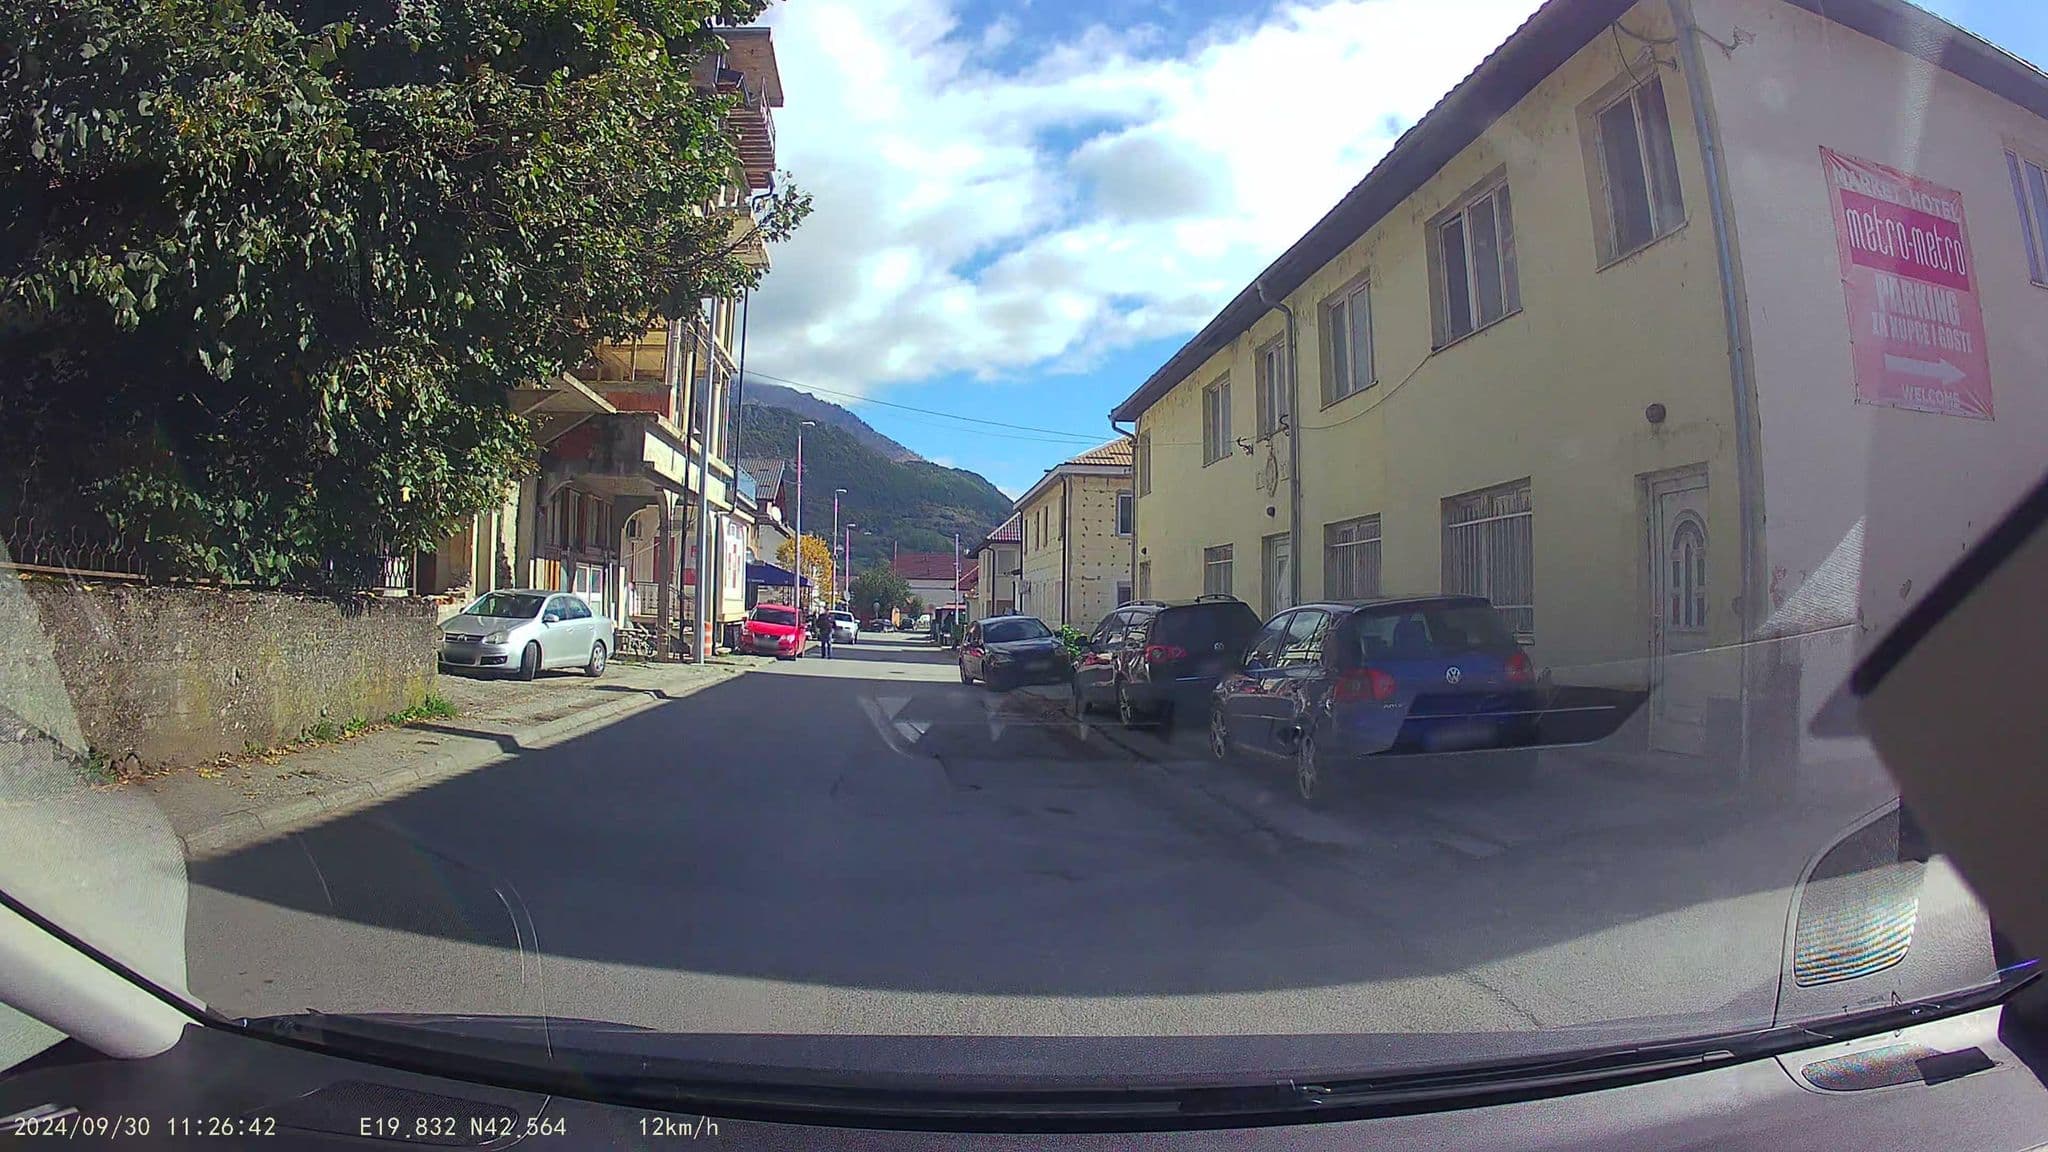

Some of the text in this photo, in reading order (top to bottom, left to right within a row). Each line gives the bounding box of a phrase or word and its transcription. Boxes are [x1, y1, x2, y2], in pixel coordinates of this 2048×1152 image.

[1909, 188, 1963, 222] HOTEL
[1845, 204, 1966, 276] metro-metro
[1874, 271, 1961, 326] PARKING
[1902, 384, 1961, 409] WELCOME
